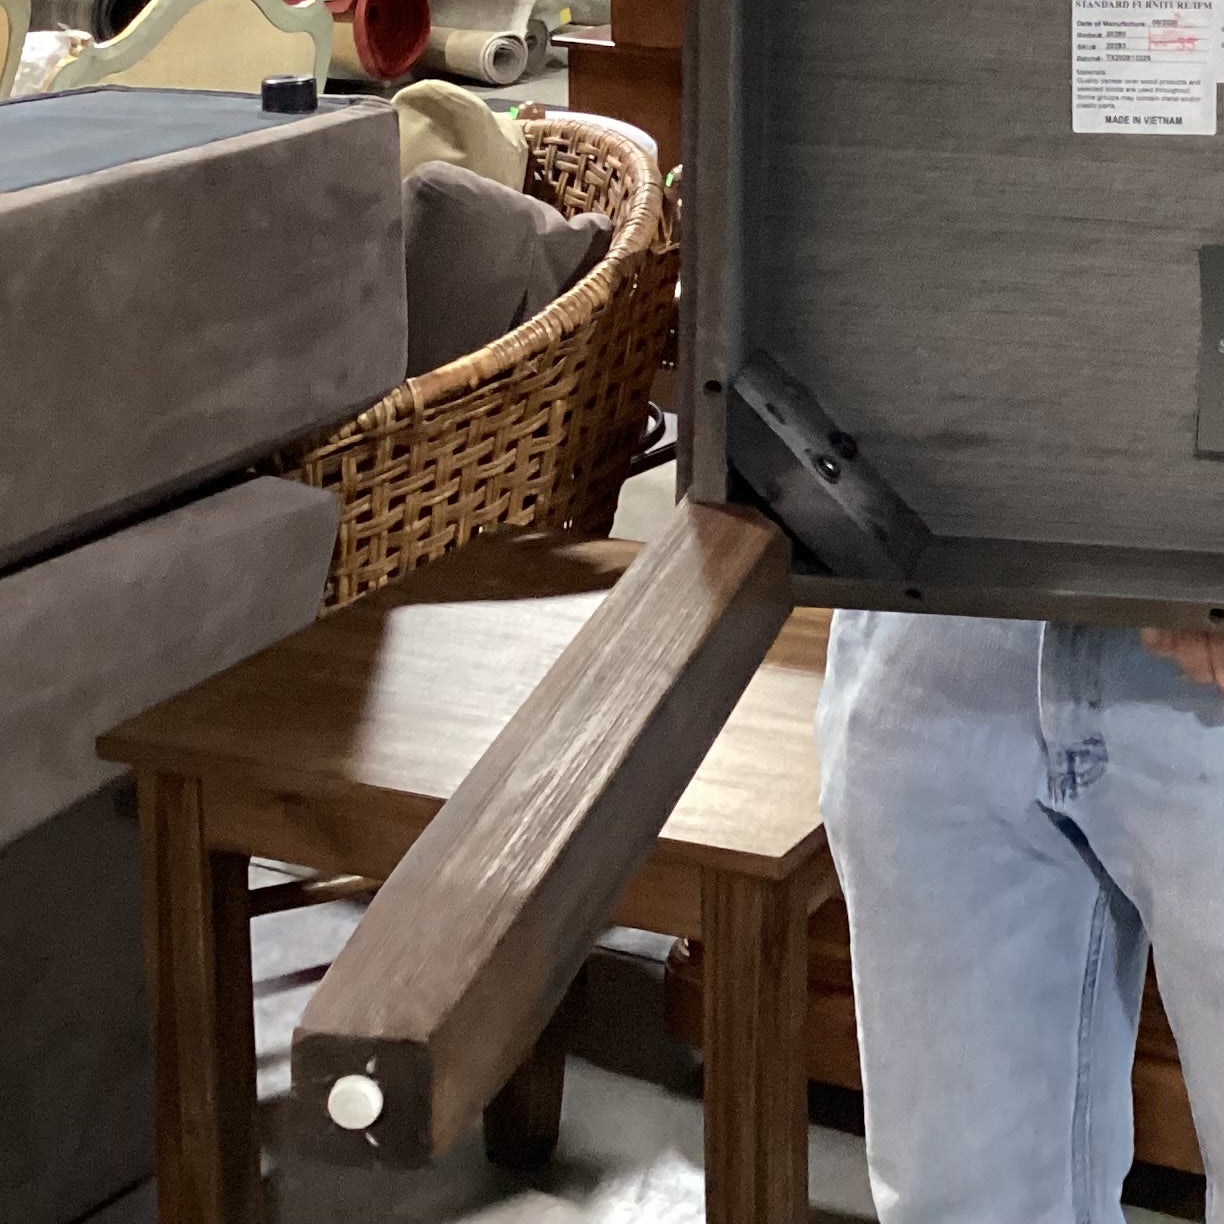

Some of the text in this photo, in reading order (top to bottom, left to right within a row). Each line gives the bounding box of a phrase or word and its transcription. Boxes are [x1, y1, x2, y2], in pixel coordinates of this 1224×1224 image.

[1075, 0, 1130, 9] STANDARD
[1105, 115, 1183, 125] MADE IN VIETNAM
